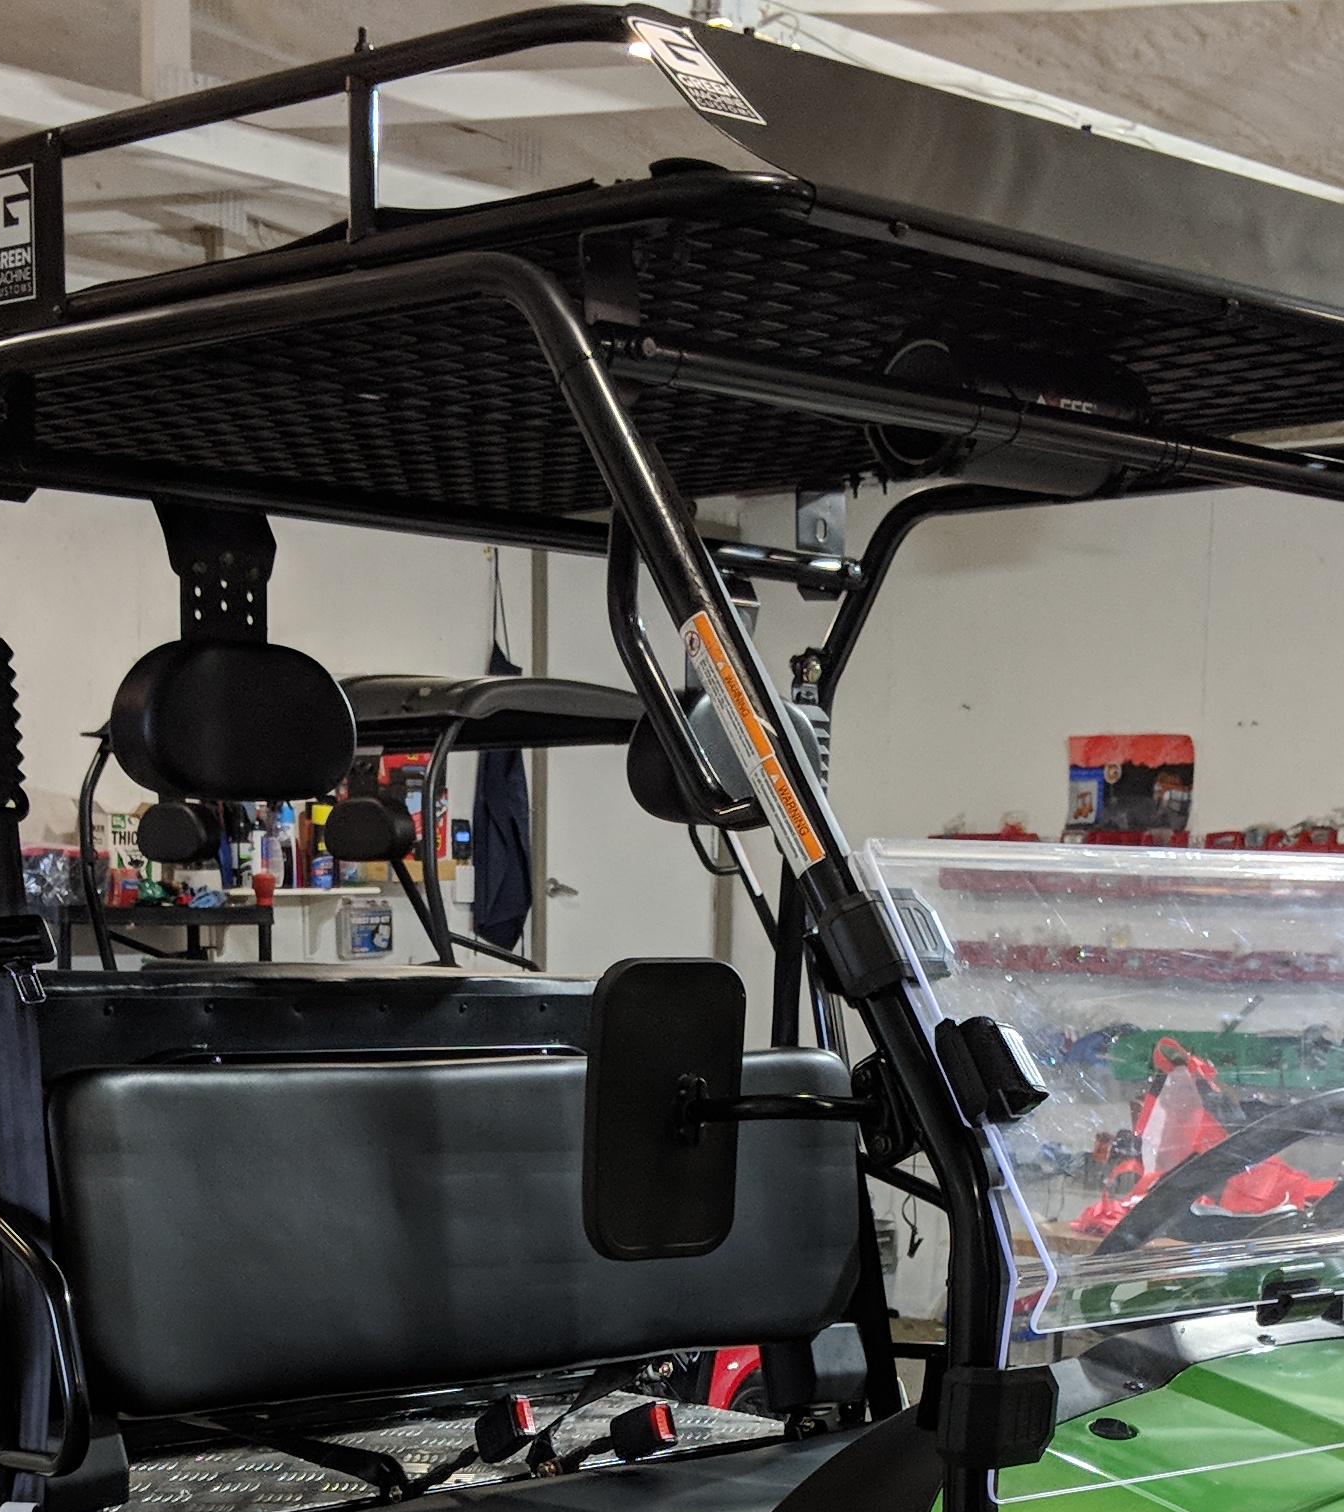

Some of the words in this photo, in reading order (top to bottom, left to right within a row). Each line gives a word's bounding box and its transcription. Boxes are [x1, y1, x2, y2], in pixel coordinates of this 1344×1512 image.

[635, 21, 726, 84] G
[676, 73, 739, 97] GREEN
[723, 674, 750, 720] WARNING
[777, 783, 810, 838] WARNING
